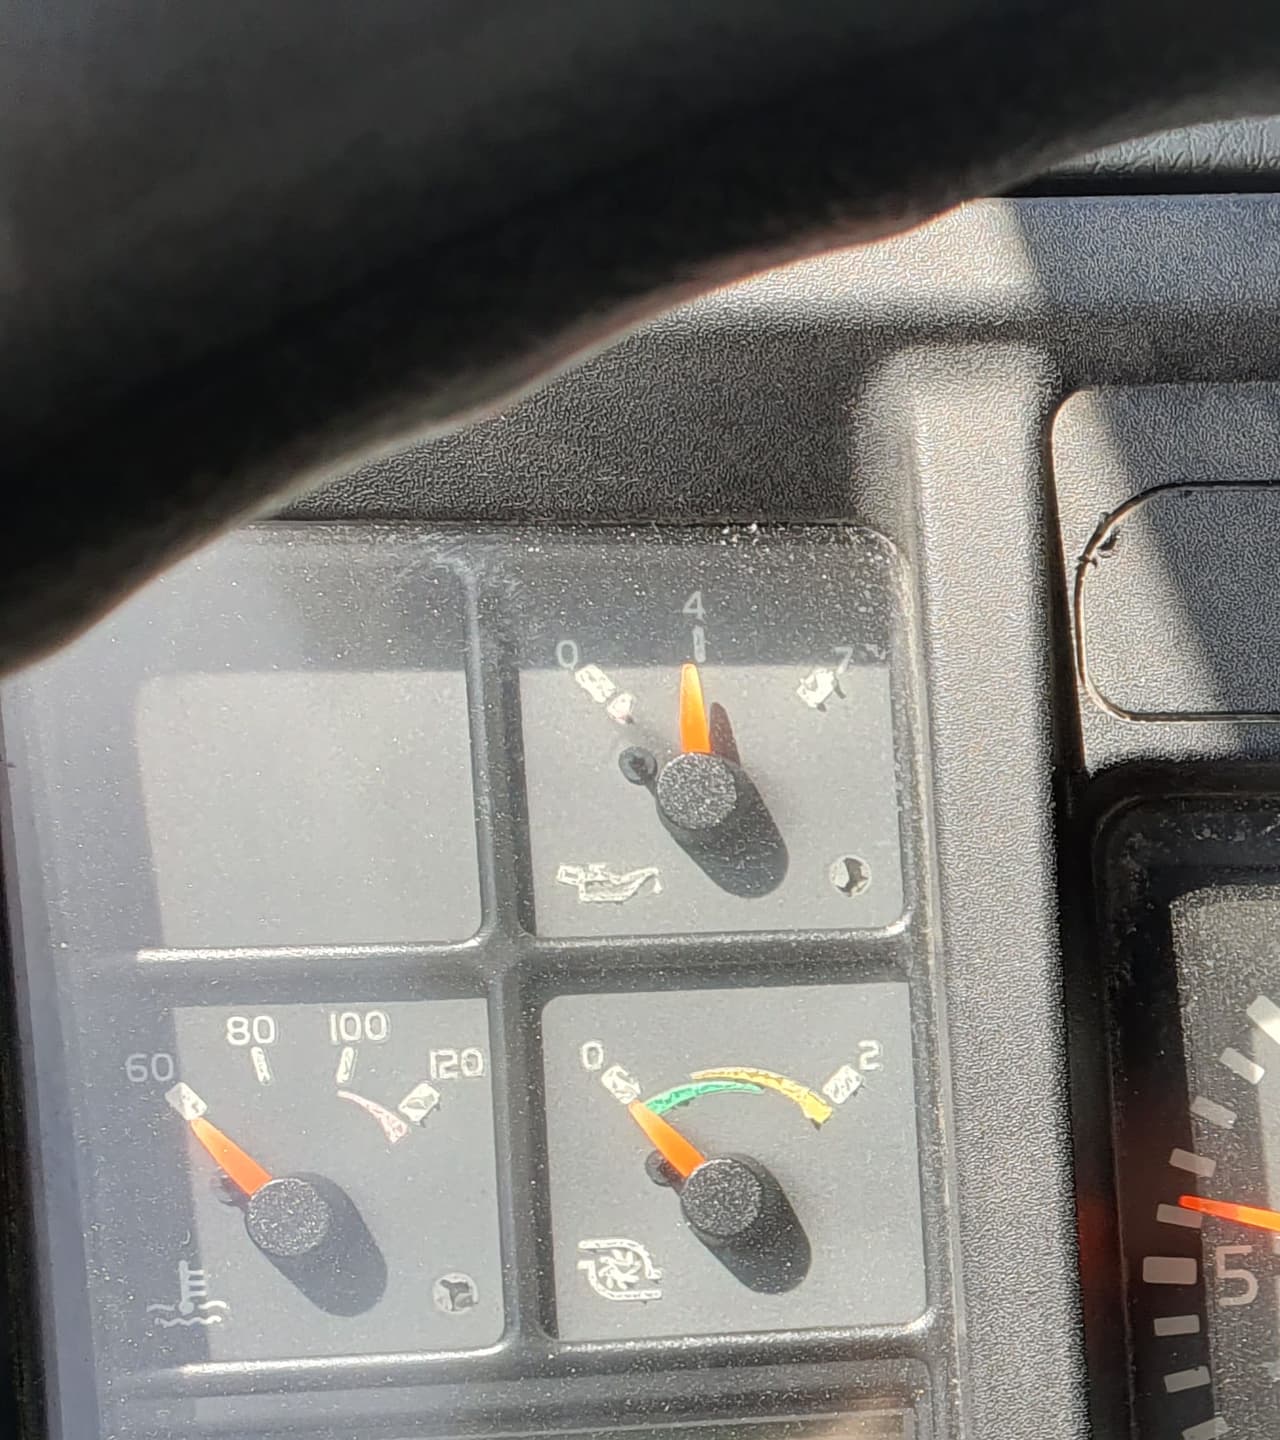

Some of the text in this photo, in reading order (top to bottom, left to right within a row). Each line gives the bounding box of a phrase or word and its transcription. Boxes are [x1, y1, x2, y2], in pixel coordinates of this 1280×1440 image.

[682, 590, 707, 620] 4
[556, 640, 579, 671] 0
[225, 1014, 278, 1046] 80
[328, 1010, 389, 1044] 100
[125, 1052, 175, 1084] 60
[428, 1047, 485, 1080] 120
[580, 1040, 605, 1074] 0
[857, 1039, 884, 1071] 2
[1215, 1245, 1259, 1307] 5
